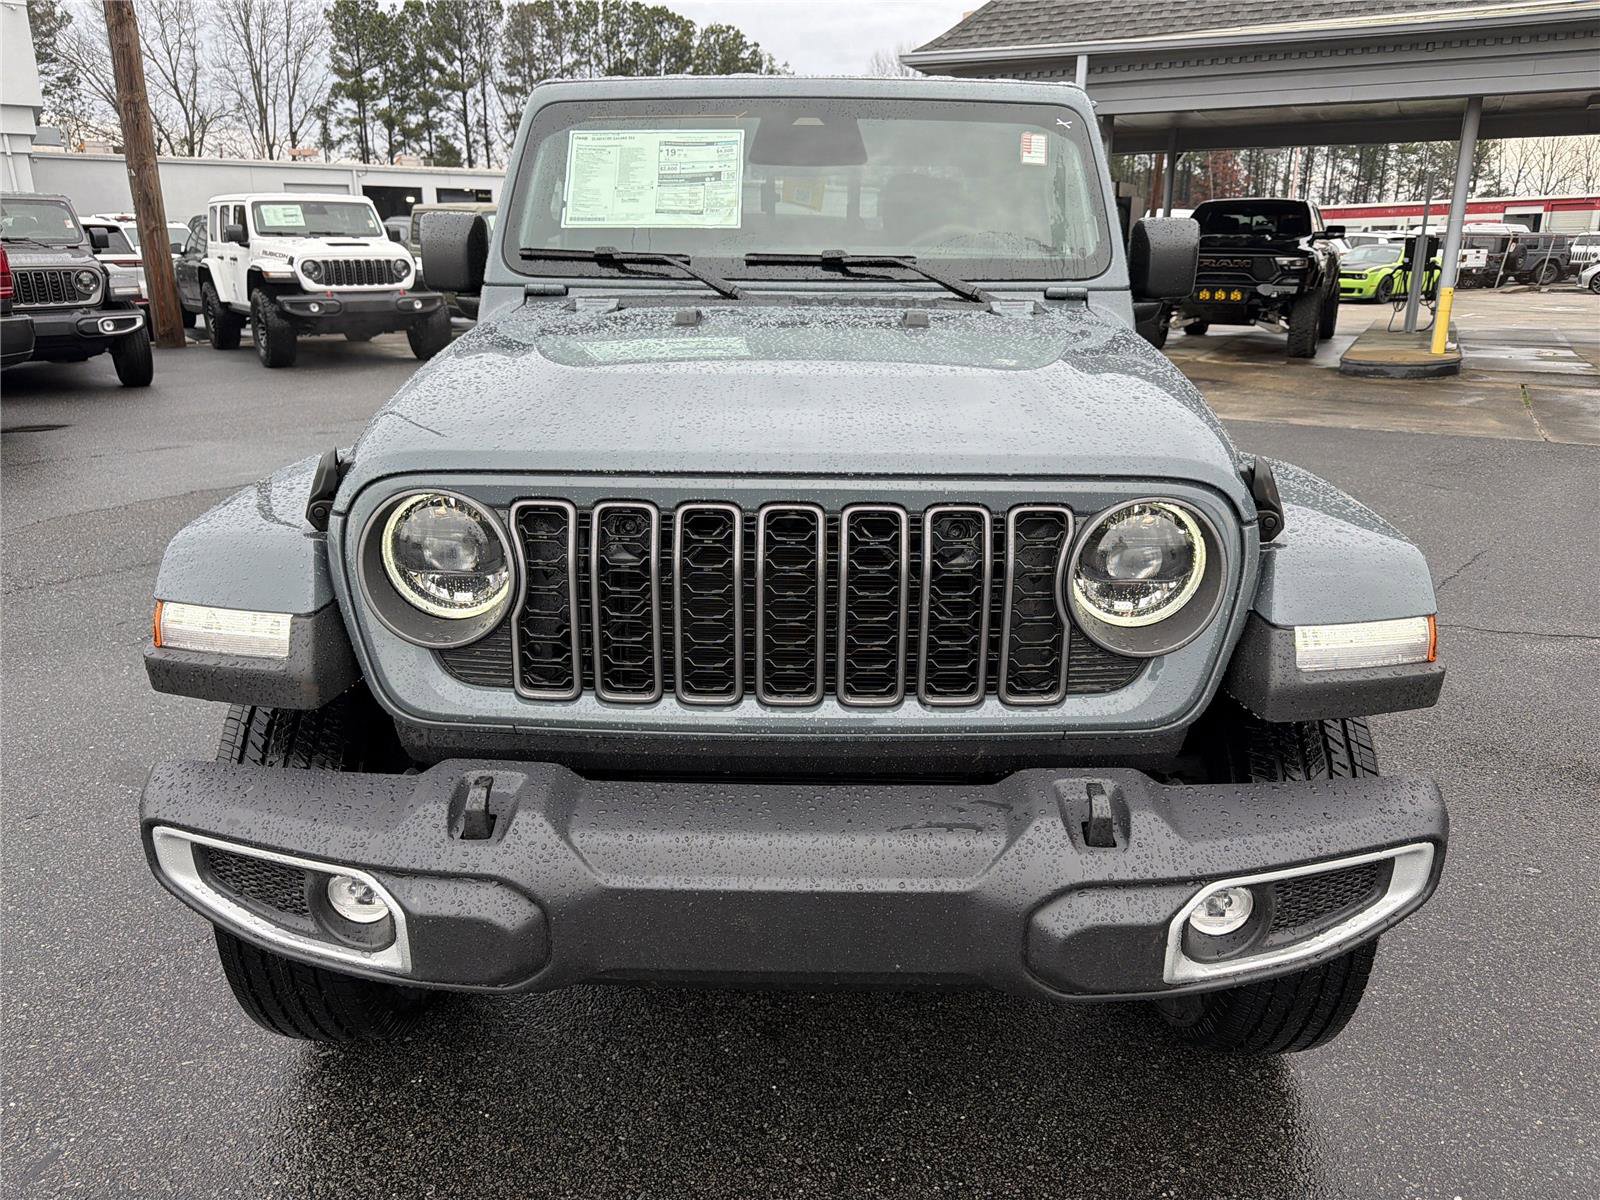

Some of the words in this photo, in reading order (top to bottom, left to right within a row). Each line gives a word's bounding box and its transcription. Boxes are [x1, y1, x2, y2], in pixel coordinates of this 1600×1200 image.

[665, 148, 677, 157] 19
[262, 250, 289, 259] RUBICON
[1198, 259, 1252, 268] RAM
